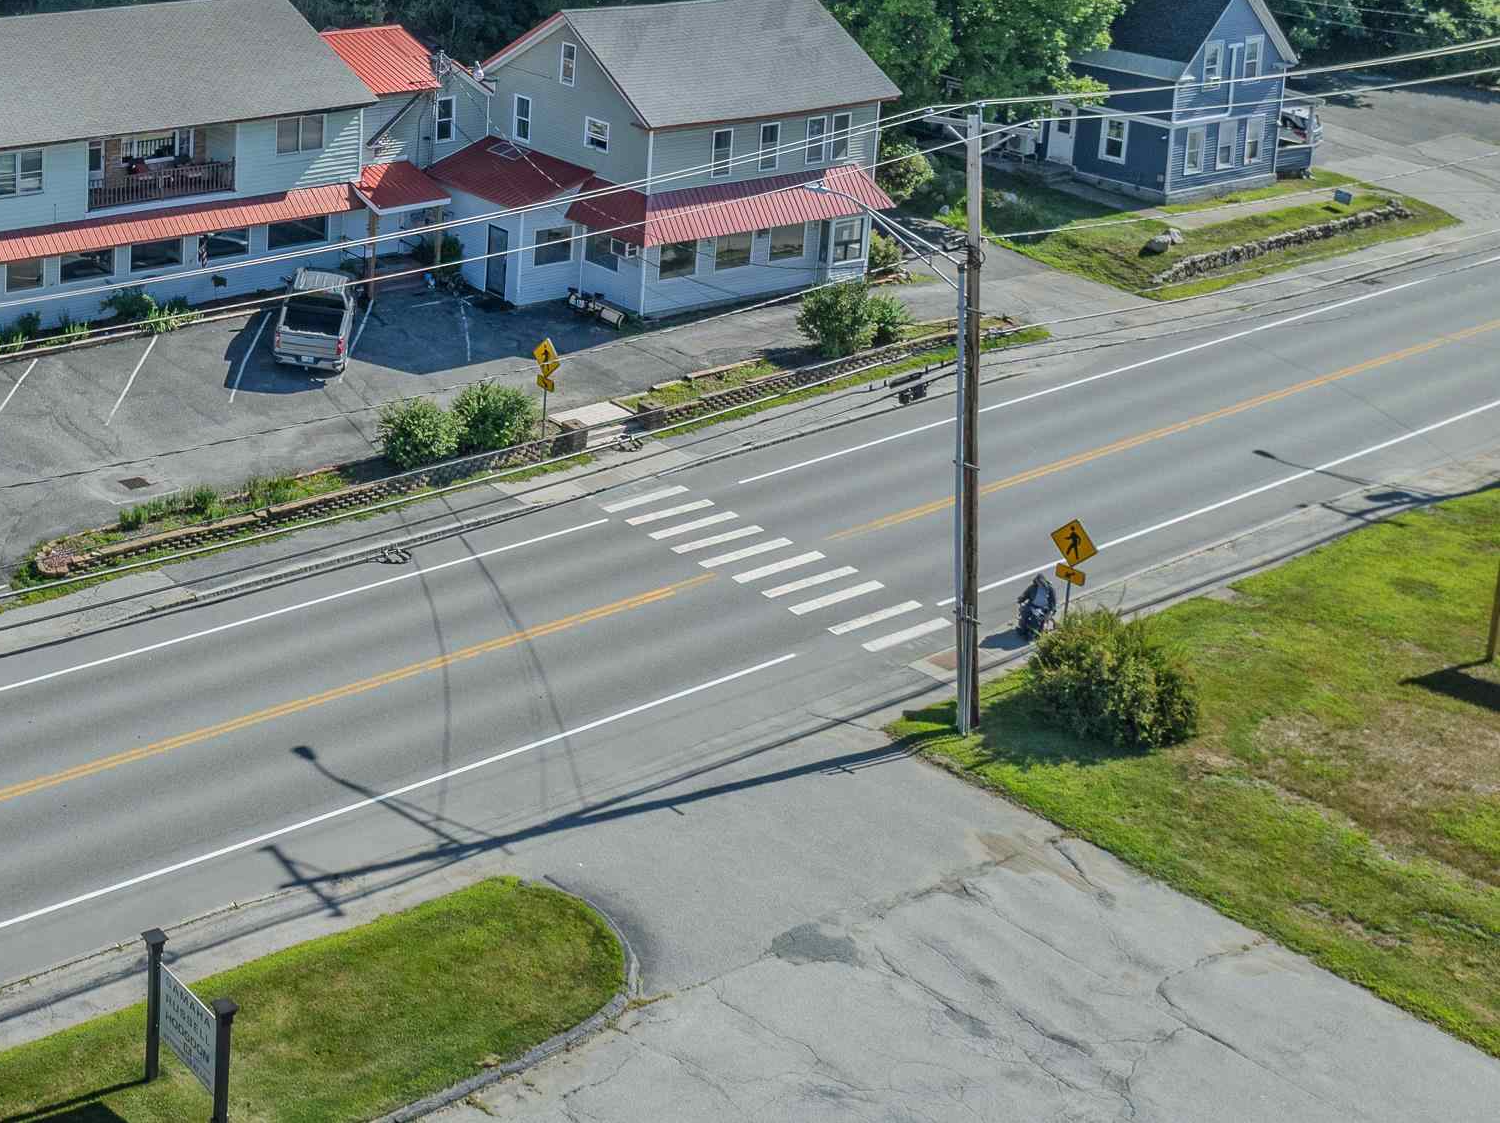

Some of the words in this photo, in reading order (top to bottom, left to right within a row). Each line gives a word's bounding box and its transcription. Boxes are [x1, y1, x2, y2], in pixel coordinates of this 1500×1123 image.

[165, 976, 211, 1029] SAMAHA
[165, 994, 210, 1046] RUSSELL
[165, 1011, 210, 1064] HODGDON
